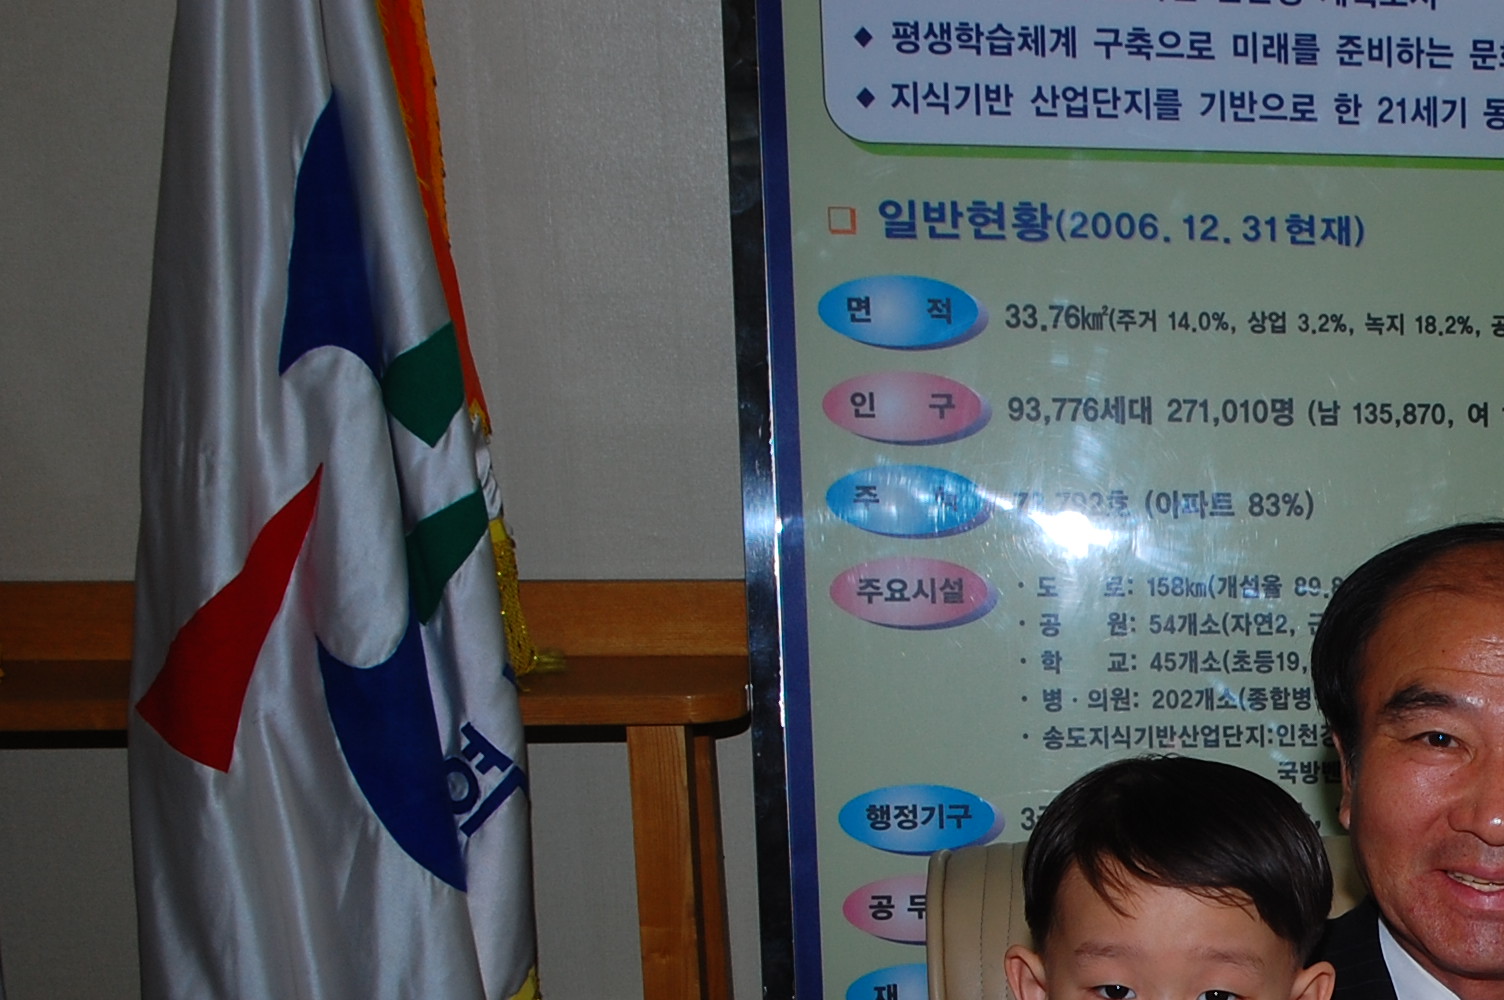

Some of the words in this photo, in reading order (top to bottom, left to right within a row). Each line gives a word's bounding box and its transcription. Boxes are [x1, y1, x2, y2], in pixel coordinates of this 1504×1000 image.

[892, 20, 1077, 59] 평생학습체계
[1093, 26, 1216, 61] 구축으로
[1233, 31, 1320, 66] 미래를
[1336, 35, 1454, 69] 준비하는
[891, 81, 1013, 116] 지식기반
[1030, 83, 1182, 121] 산업단지를
[1199, 89, 1318, 124] 기반으로
[1333, 92, 1363, 126] 한
[1378, 96, 1467, 129] 21세기
[1247, 311, 1287, 334] 상업
[1364, 312, 1405, 336] 녹지
[1467, 401, 1489, 428] 여
[856, 576, 965, 604] 주요시설
[1152, 686, 1317, 712] 202개소(종합병
[866, 804, 973, 830] 행정기구
